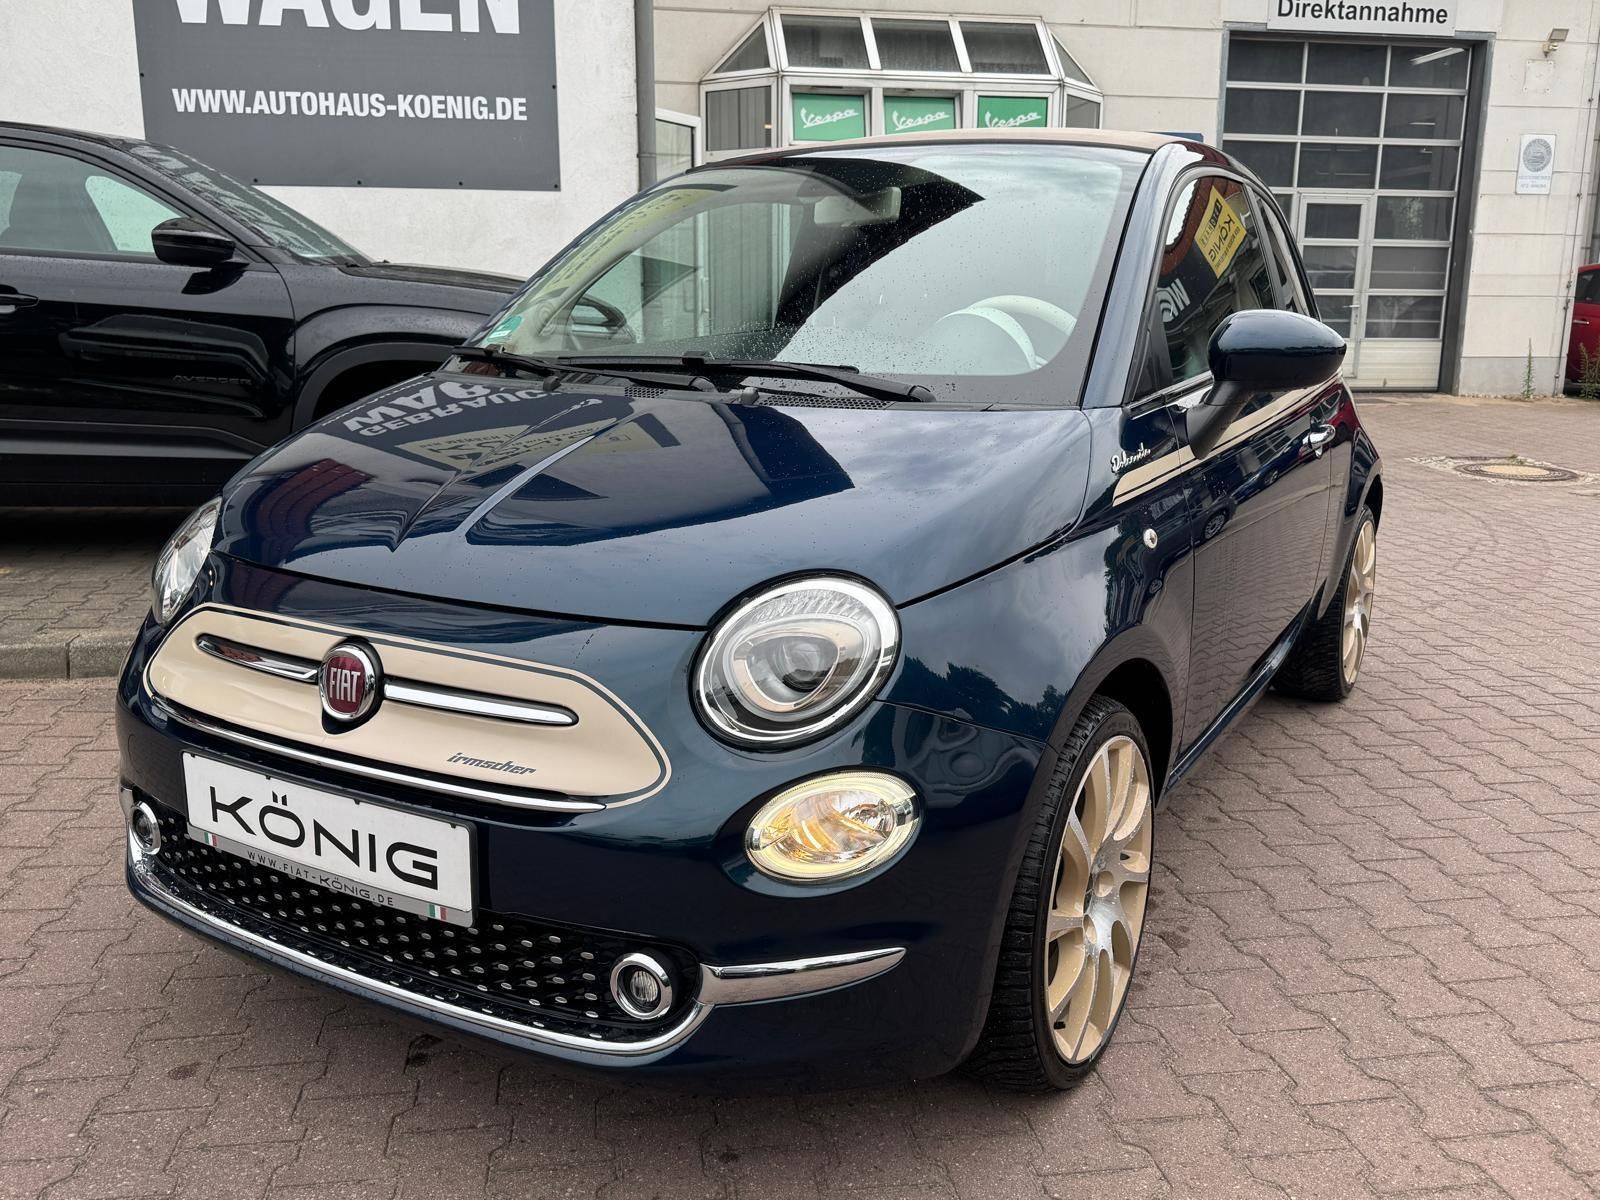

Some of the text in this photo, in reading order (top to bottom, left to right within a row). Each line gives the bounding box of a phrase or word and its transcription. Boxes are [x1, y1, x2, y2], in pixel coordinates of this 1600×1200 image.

[1277, 0, 1448, 24] Direktannahme
[171, 88, 528, 121] WWW.AUTOHAUS-KOENIG.DE
[800, 107, 860, 129] Vespa
[892, 110, 950, 131] Vespa
[984, 111, 1042, 128] Vespa
[329, 667, 361, 703] FIAT
[446, 752, 537, 775] irmscher
[209, 785, 439, 891] KÖNIG
